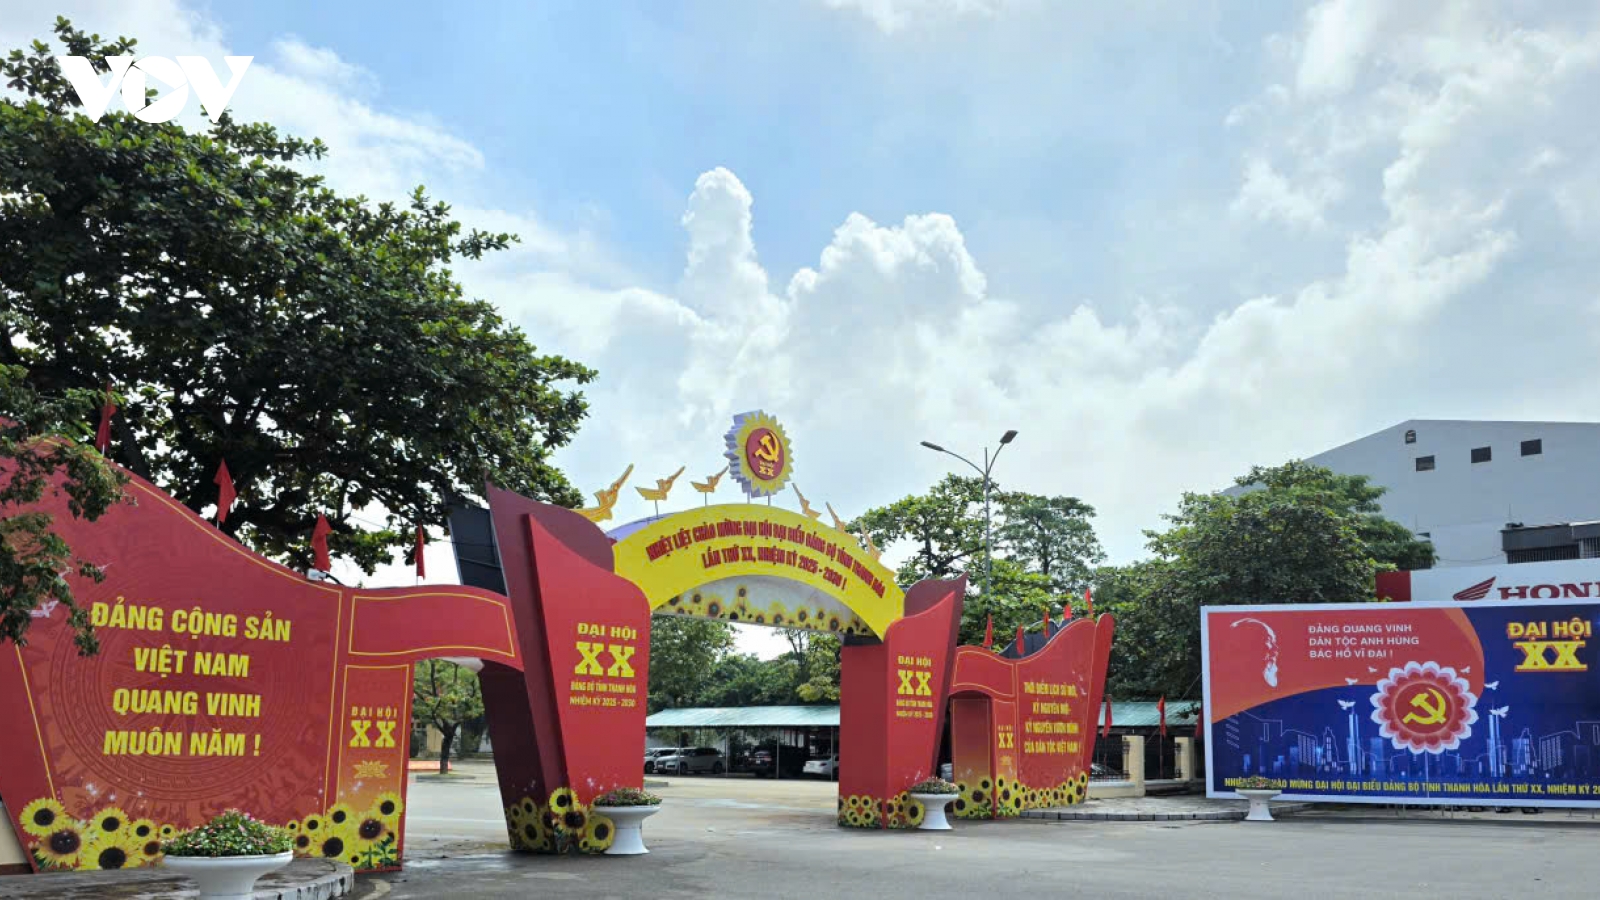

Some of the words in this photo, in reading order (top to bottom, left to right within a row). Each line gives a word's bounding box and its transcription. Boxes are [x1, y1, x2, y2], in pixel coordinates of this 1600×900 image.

[672, 528, 692, 550] LIỆT
[692, 521, 716, 542] CHÀO
[91, 596, 164, 631] ĐẢNG
[172, 606, 237, 640] CỘNG
[245, 610, 291, 642] SẢN
[577, 622, 605, 638] ĐẠI
[611, 625, 637, 640] HỘI
[1308, 623, 1340, 633] ĐẢNG
[1343, 624, 1382, 633] QUANG
[1385, 624, 1412, 632] VINH
[1506, 621, 1547, 641] ĐẠI
[1552, 617, 1592, 641] HỘI
[1309, 636, 1332, 646] DÂN
[1335, 636, 1357, 647] TỘC
[1360, 637, 1384, 645] ANH
[1310, 648, 1333, 658] BÁC
[134, 644, 188, 678] VIỆT
[194, 651, 249, 678] NAM
[575, 641, 635, 678] XX
[1513, 641, 1587, 672] XX
[898, 669, 932, 696] XX
[112, 688, 199, 716] QUANG
[206, 692, 261, 717] VINH
[351, 706, 372, 719] ĐẠI
[103, 726, 183, 756] MUÔN
[190, 727, 245, 757] NĂM
[254, 734, 261, 757] !
[1443, 782, 1471, 793] THANH
[1547, 783, 1577, 796] NHIỆM
